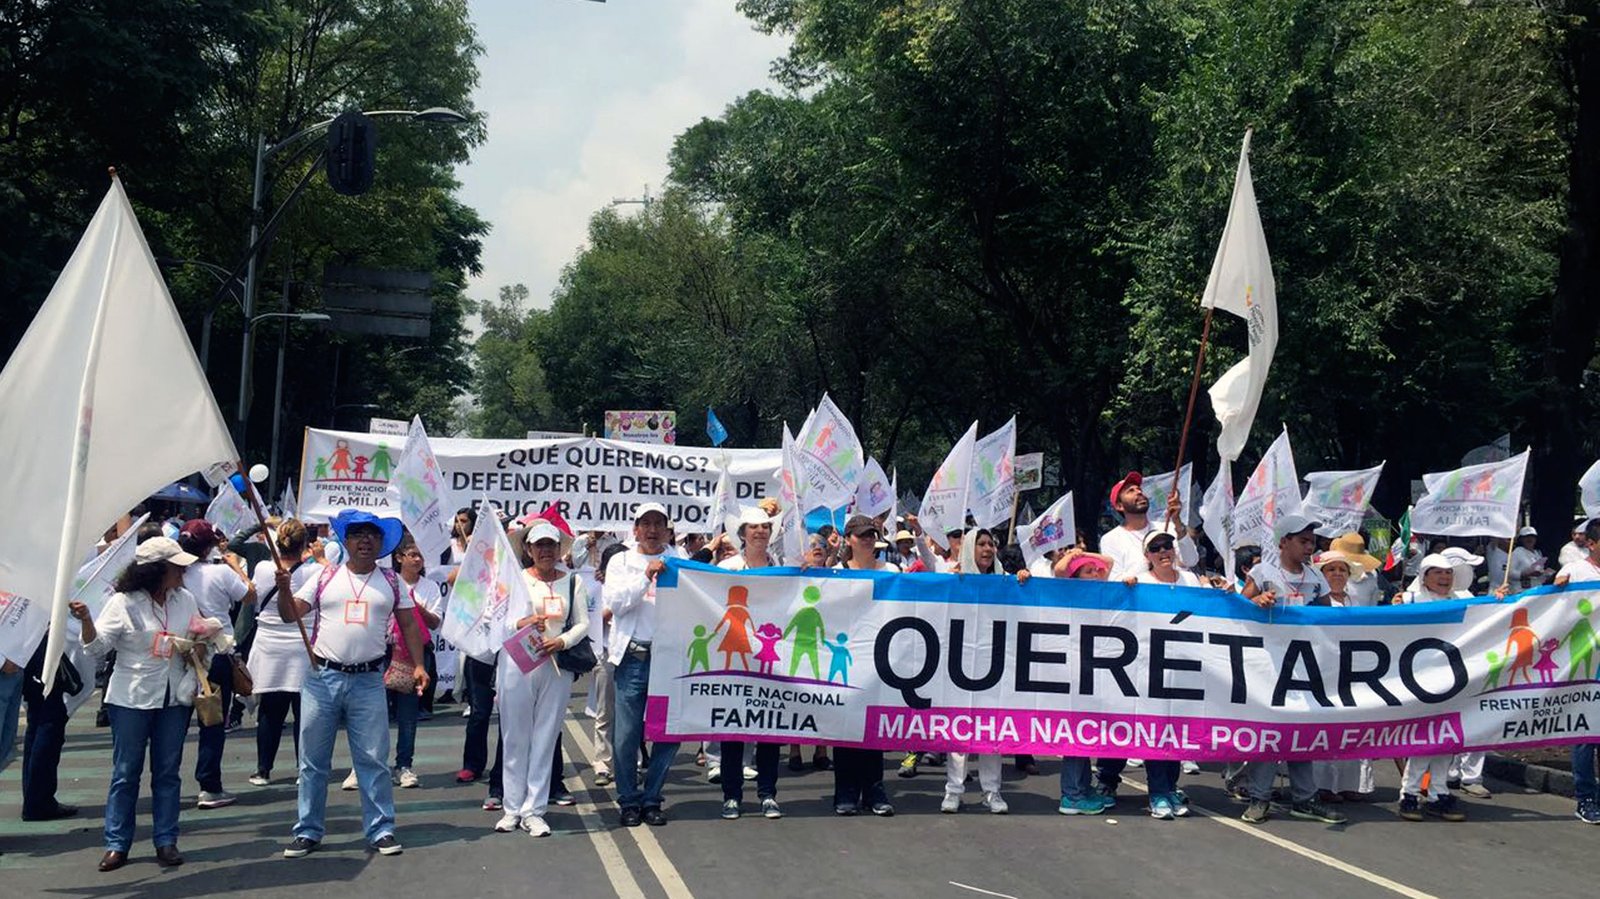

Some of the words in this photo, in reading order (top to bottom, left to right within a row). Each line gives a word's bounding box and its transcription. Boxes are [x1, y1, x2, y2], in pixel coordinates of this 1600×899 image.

[496, 444, 559, 469] ¿QUÉ
[565, 446, 709, 473] QUEREMOS?
[316, 483, 353, 492] FRENTE
[452, 471, 580, 493] DEFENDER
[587, 474, 612, 493] EL
[619, 475, 719, 497] DERECH
[736, 481, 766, 499] DE
[328, 495, 389, 507] FAMILIA
[576, 501, 592, 521] A
[662, 503, 712, 523] IJOS
[435, 634, 446, 652] la
[873, 611, 1469, 710] QUERÉTARO
[690, 683, 753, 697] FRENTE
[758, 686, 845, 706] NACIONAL
[745, 698, 768, 708] POR
[771, 701, 786, 710] LA
[1480, 697, 1539, 711] FRENTE
[1543, 690, 1600, 708] NACIONA
[711, 707, 818, 733] FAMILIA
[1532, 708, 1551, 717] POR
[1552, 706, 1563, 715] LA
[877, 713, 1020, 743] MARCHA
[1030, 716, 1200, 750] NACIONAL
[1211, 725, 1281, 753] POR
[1290, 729, 1330, 751] LA
[1339, 719, 1460, 750] FAMILIA
[1502, 713, 1590, 738] FAMILIA
